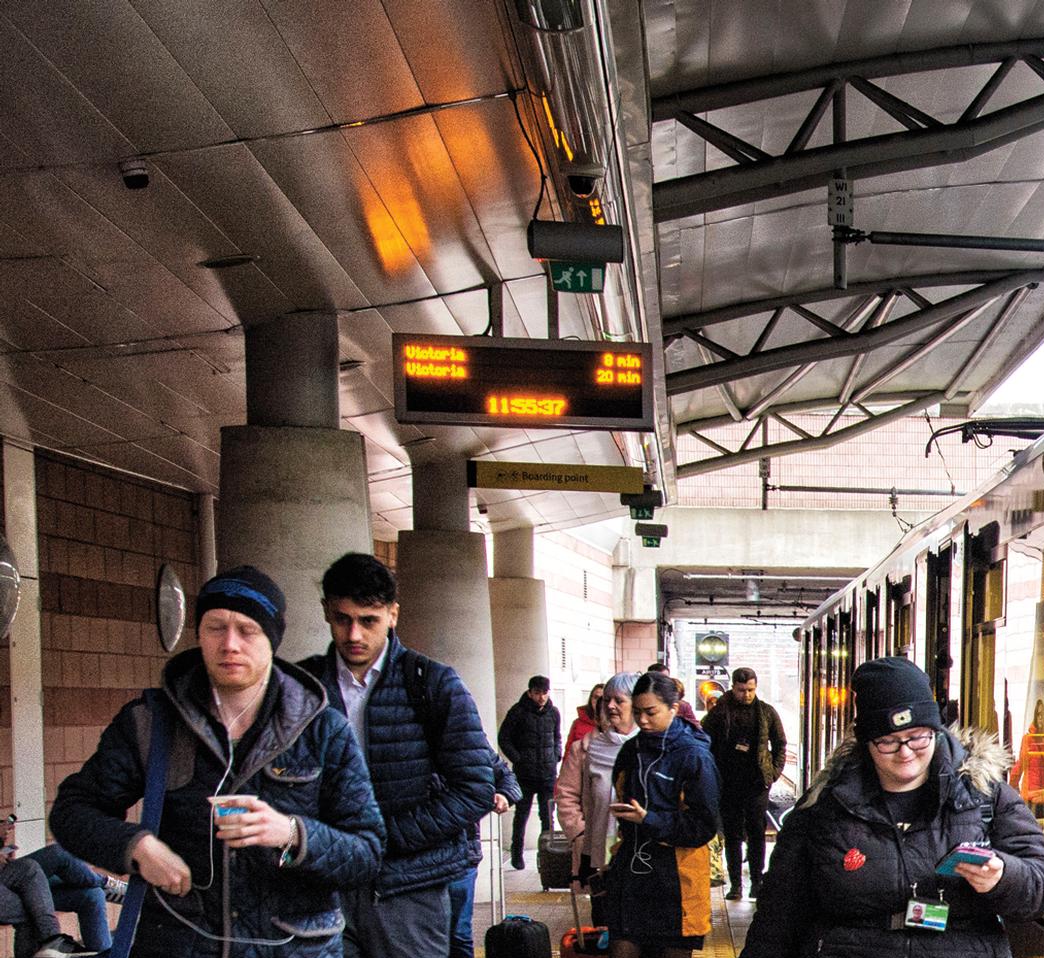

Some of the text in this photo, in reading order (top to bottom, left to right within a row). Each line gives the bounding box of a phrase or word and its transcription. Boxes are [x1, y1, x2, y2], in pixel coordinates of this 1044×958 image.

[405, 345, 466, 361] Victoria
[603, 353, 641, 368] 8 min
[406, 362, 466, 377] Victoria
[597, 370, 641, 384] 20 min
[522, 471, 589, 484] Boarding point
